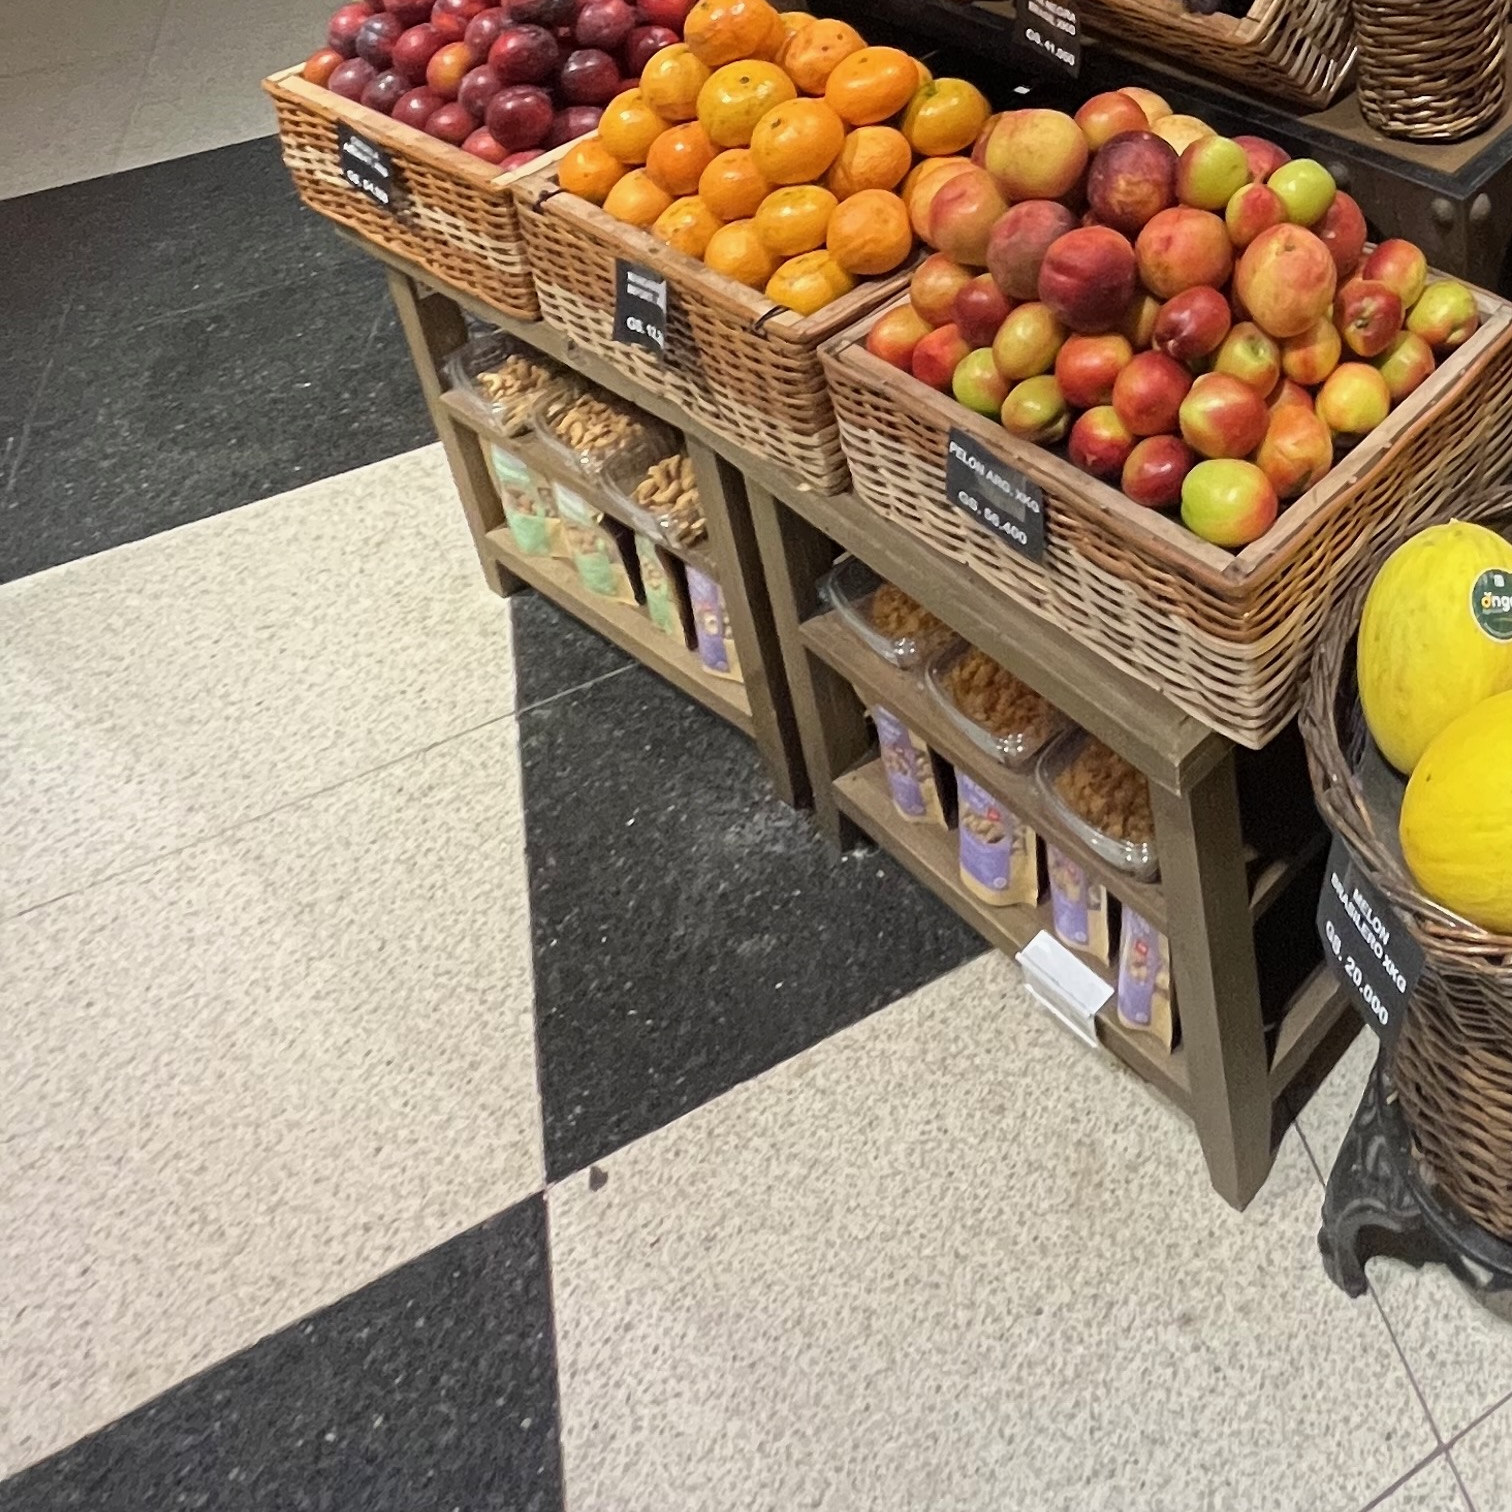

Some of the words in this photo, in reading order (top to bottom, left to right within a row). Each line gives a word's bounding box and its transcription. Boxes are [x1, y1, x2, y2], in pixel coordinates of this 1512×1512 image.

[958, 490, 982, 515] GS.
[1353, 888, 1390, 946] MELON
[1326, 920, 1343, 962] GS.
[1344, 955, 1389, 1025] 20.000
[1382, 954, 1407, 994] XKG
